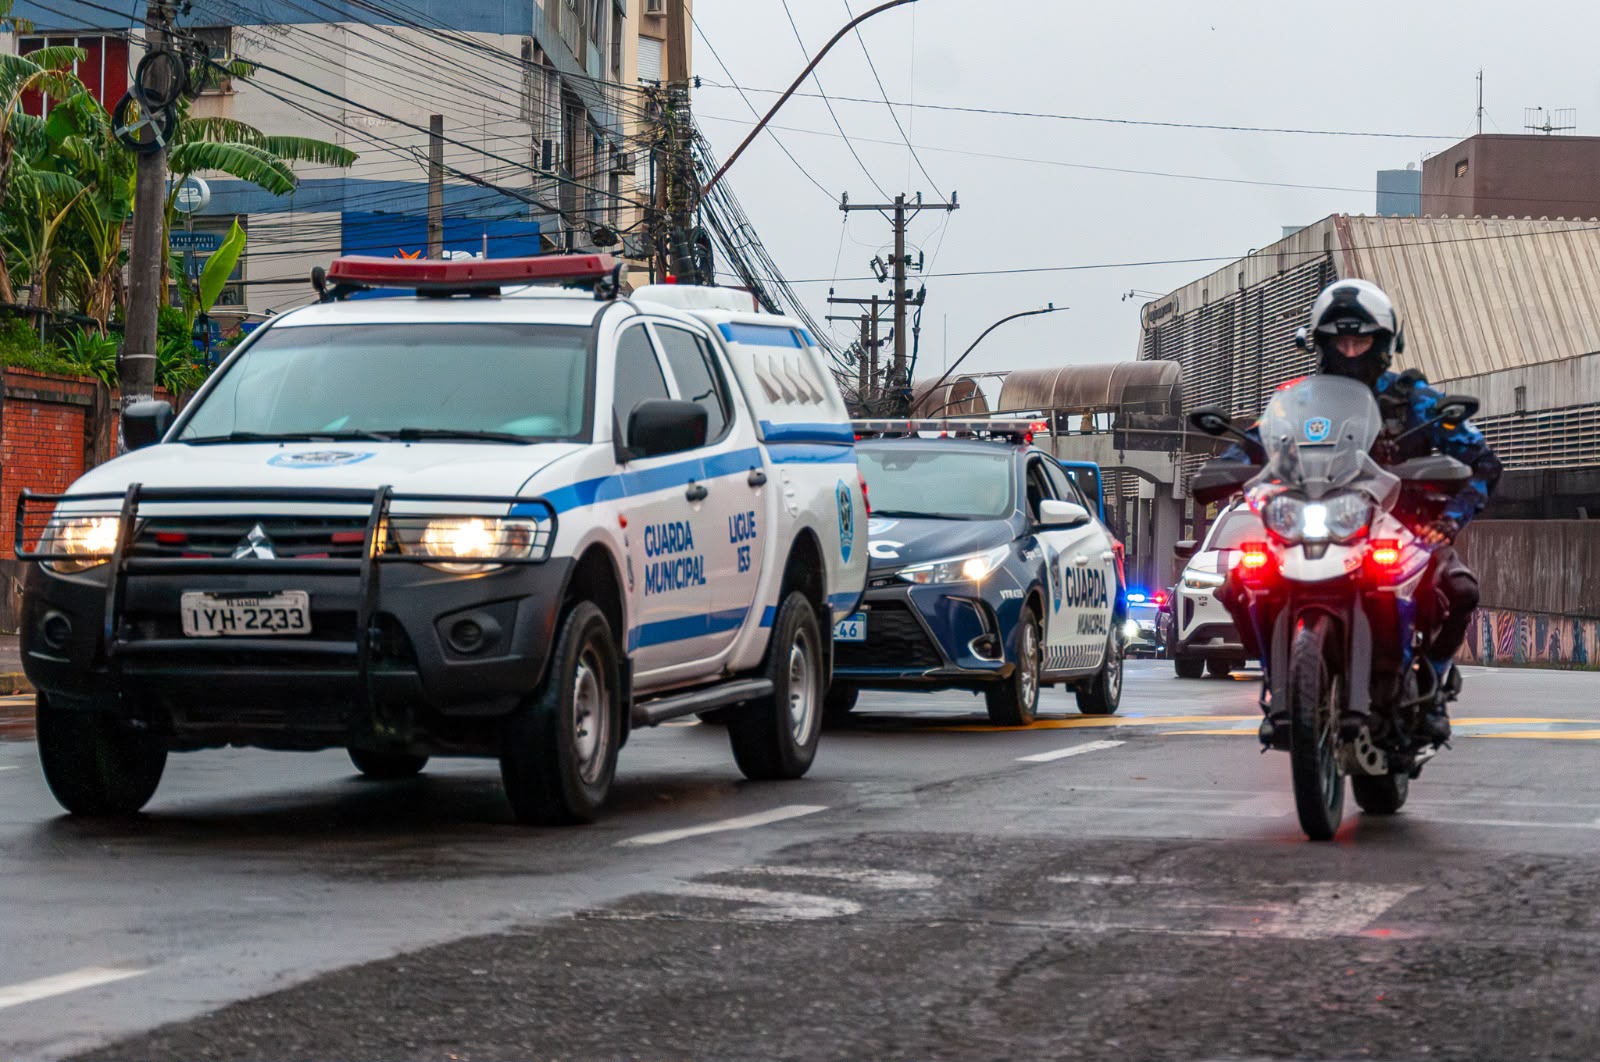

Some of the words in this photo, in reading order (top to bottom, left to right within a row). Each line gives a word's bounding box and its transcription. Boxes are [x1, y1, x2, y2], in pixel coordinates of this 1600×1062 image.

[644, 520, 694, 557] GUARDA
[728, 511, 757, 544] LIGUE
[645, 555, 706, 596] MUNICIPAL
[737, 545, 751, 573] 153
[1065, 566, 1108, 609] GUARDA
[833, 622, 857, 638] 46
